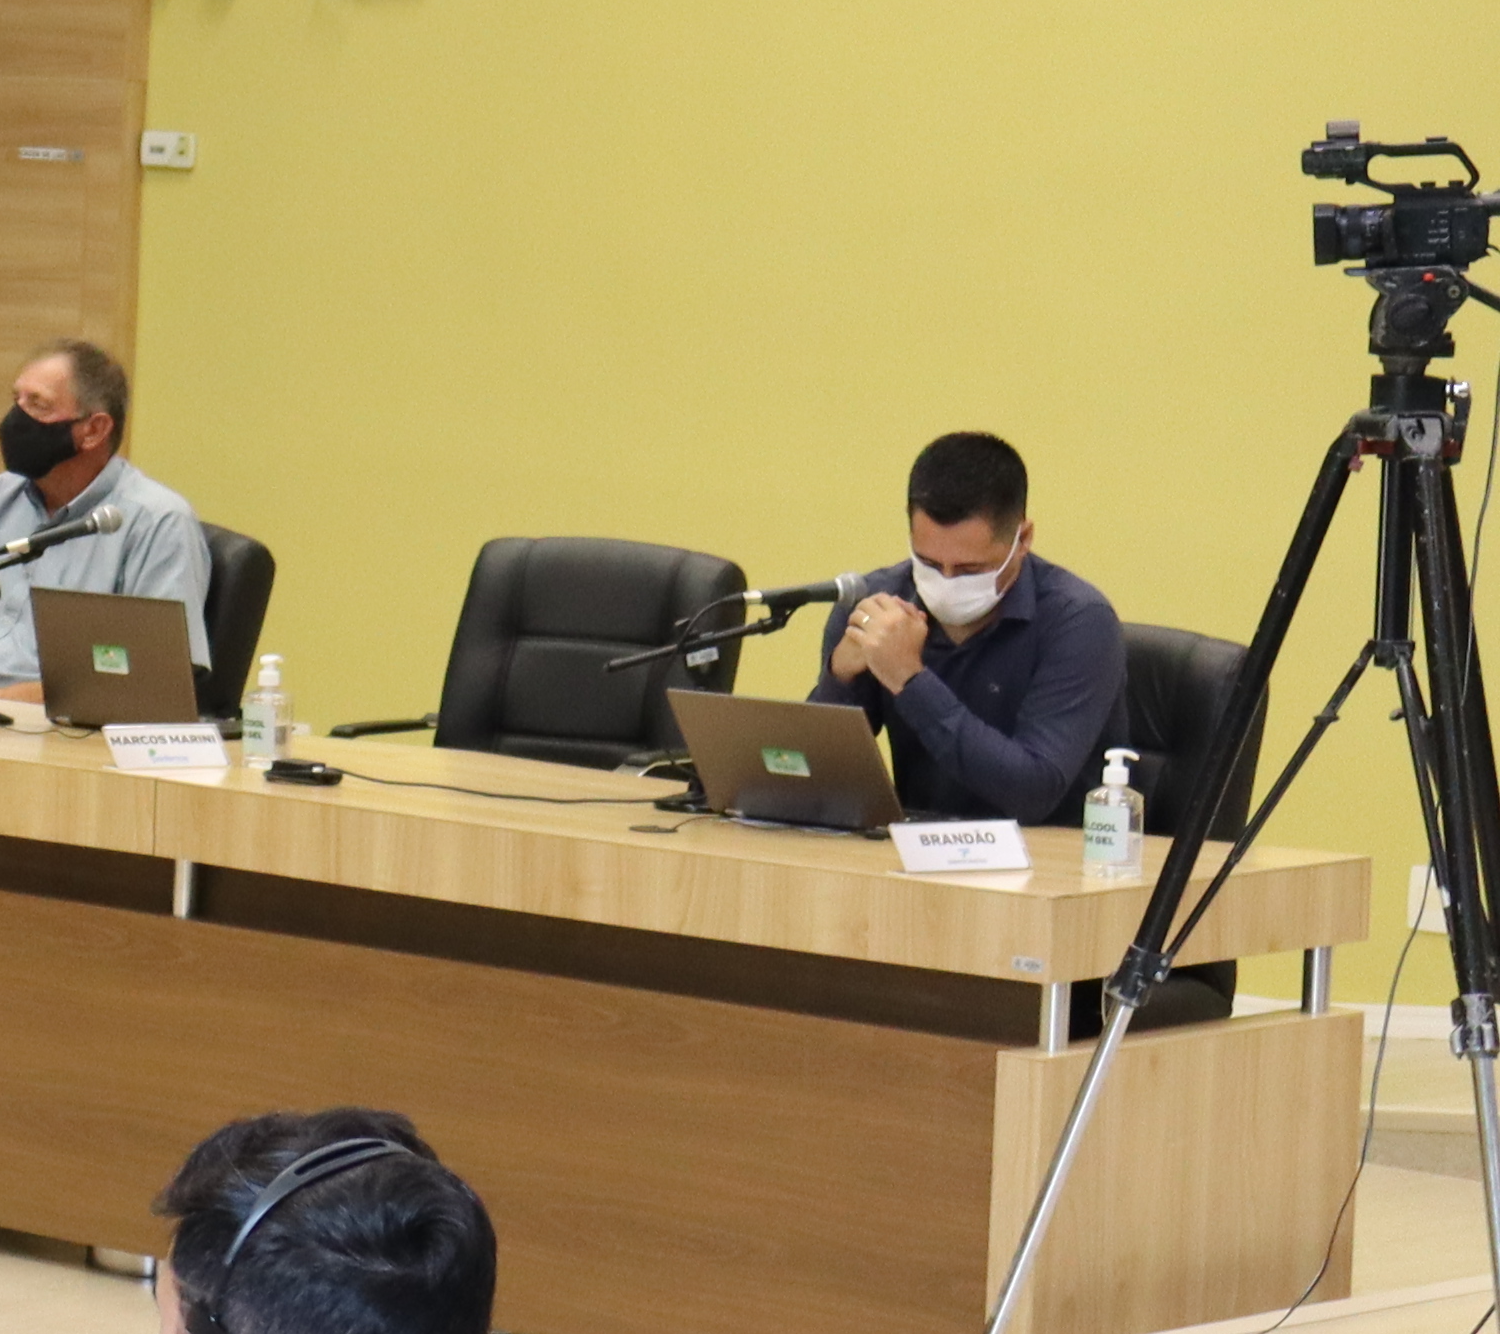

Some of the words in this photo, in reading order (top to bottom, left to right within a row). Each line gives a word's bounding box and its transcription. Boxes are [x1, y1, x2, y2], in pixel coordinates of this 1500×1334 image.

[110, 734, 168, 746] MARCOS
[170, 733, 216, 744] MARINI
[919, 830, 997, 846] BRANDÃO
